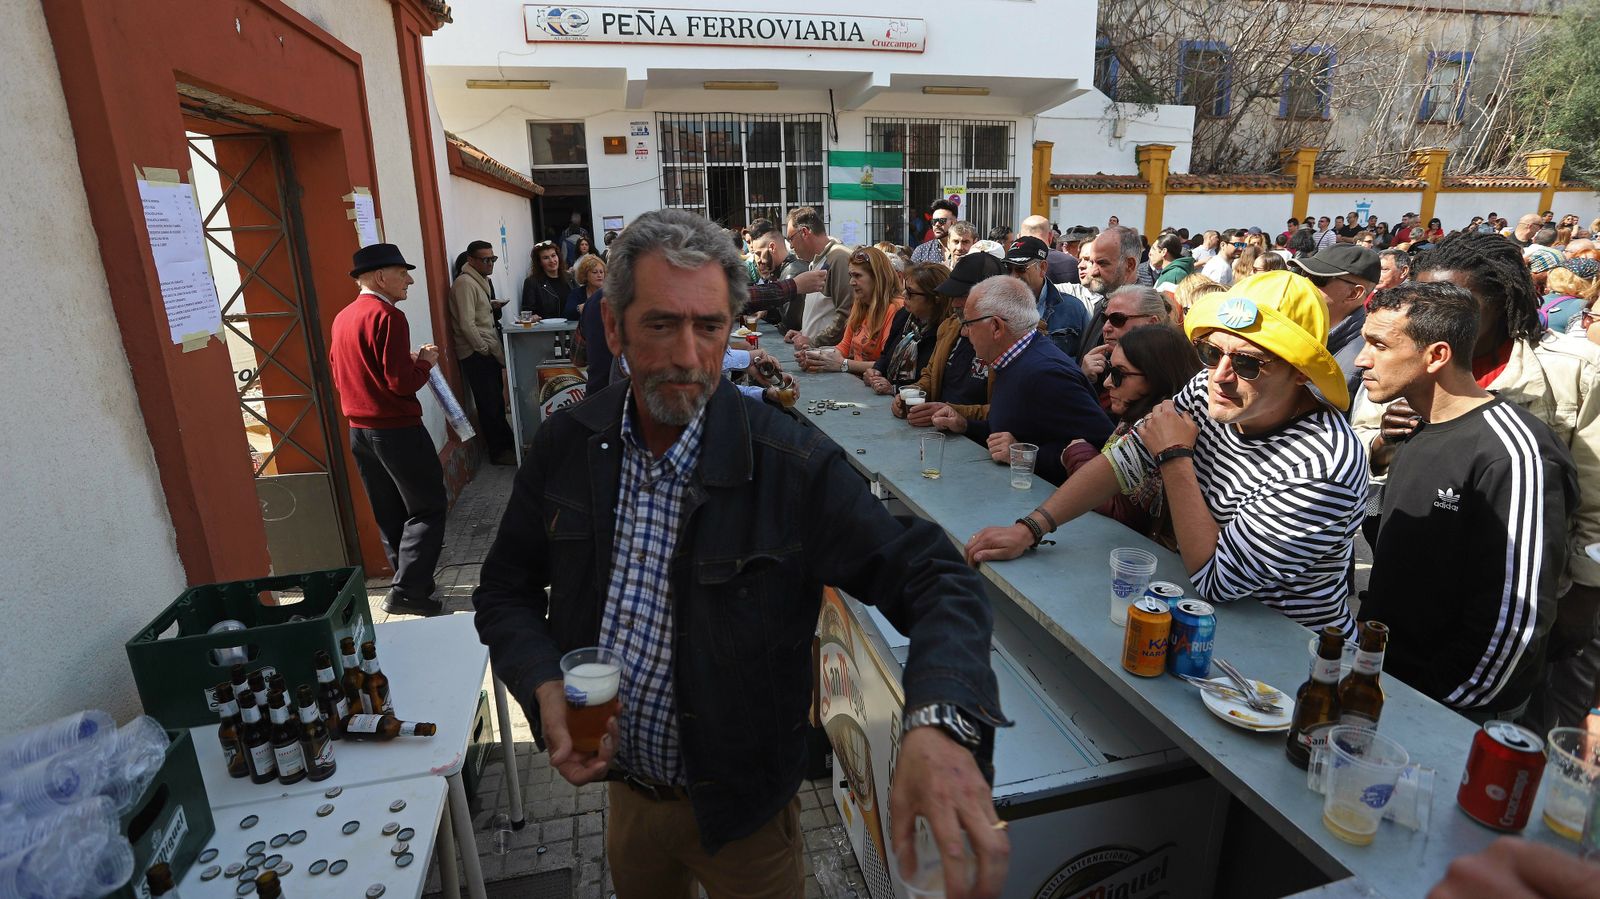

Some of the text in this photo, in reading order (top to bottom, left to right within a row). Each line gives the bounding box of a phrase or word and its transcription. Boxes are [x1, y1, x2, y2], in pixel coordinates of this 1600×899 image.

[602, 9, 865, 42] PEÑA FERROVIARIA
[872, 39, 917, 49] Cruzcampo
[1433, 501, 1459, 512] adidas
[1149, 639, 1168, 649] KA
[1171, 633, 1213, 653] UARIUS
